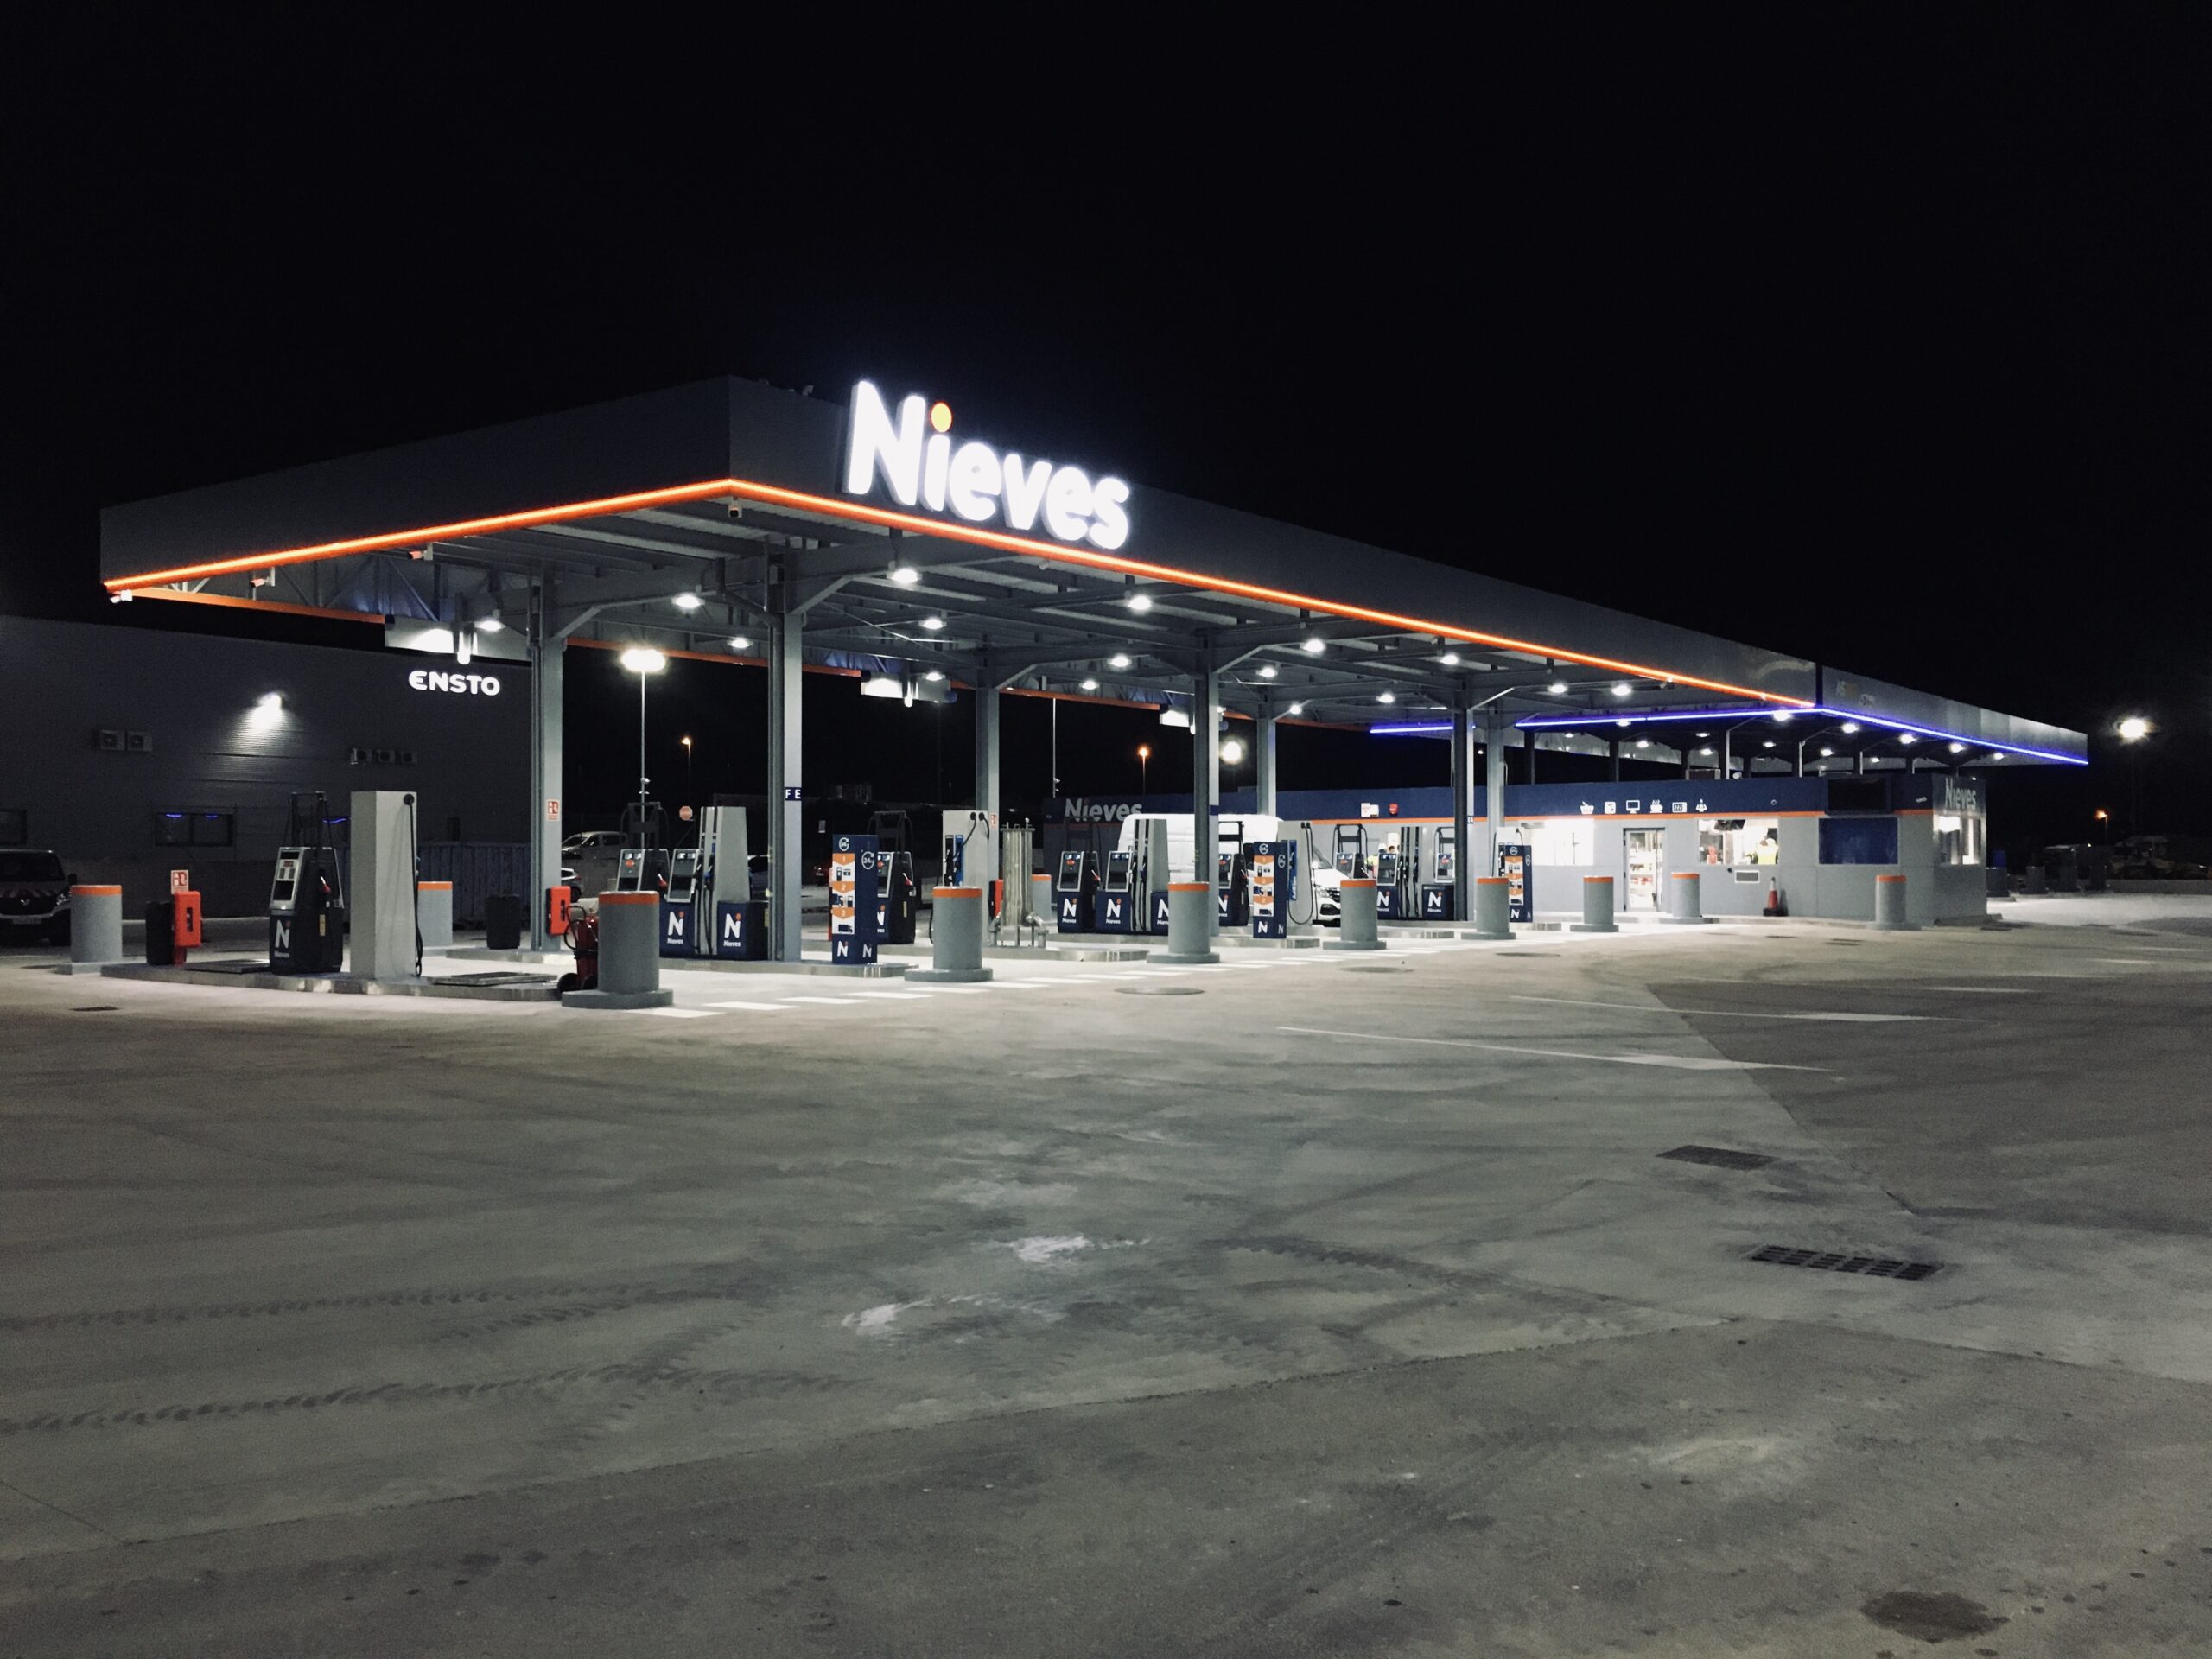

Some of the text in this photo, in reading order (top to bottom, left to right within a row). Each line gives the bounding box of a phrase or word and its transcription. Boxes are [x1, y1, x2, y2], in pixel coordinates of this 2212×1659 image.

[847, 379, 1130, 550] Nieves
[409, 671, 500, 696] ENSTO
[1945, 778, 1977, 810] Nieves
[1065, 798, 1143, 822] Nieves
